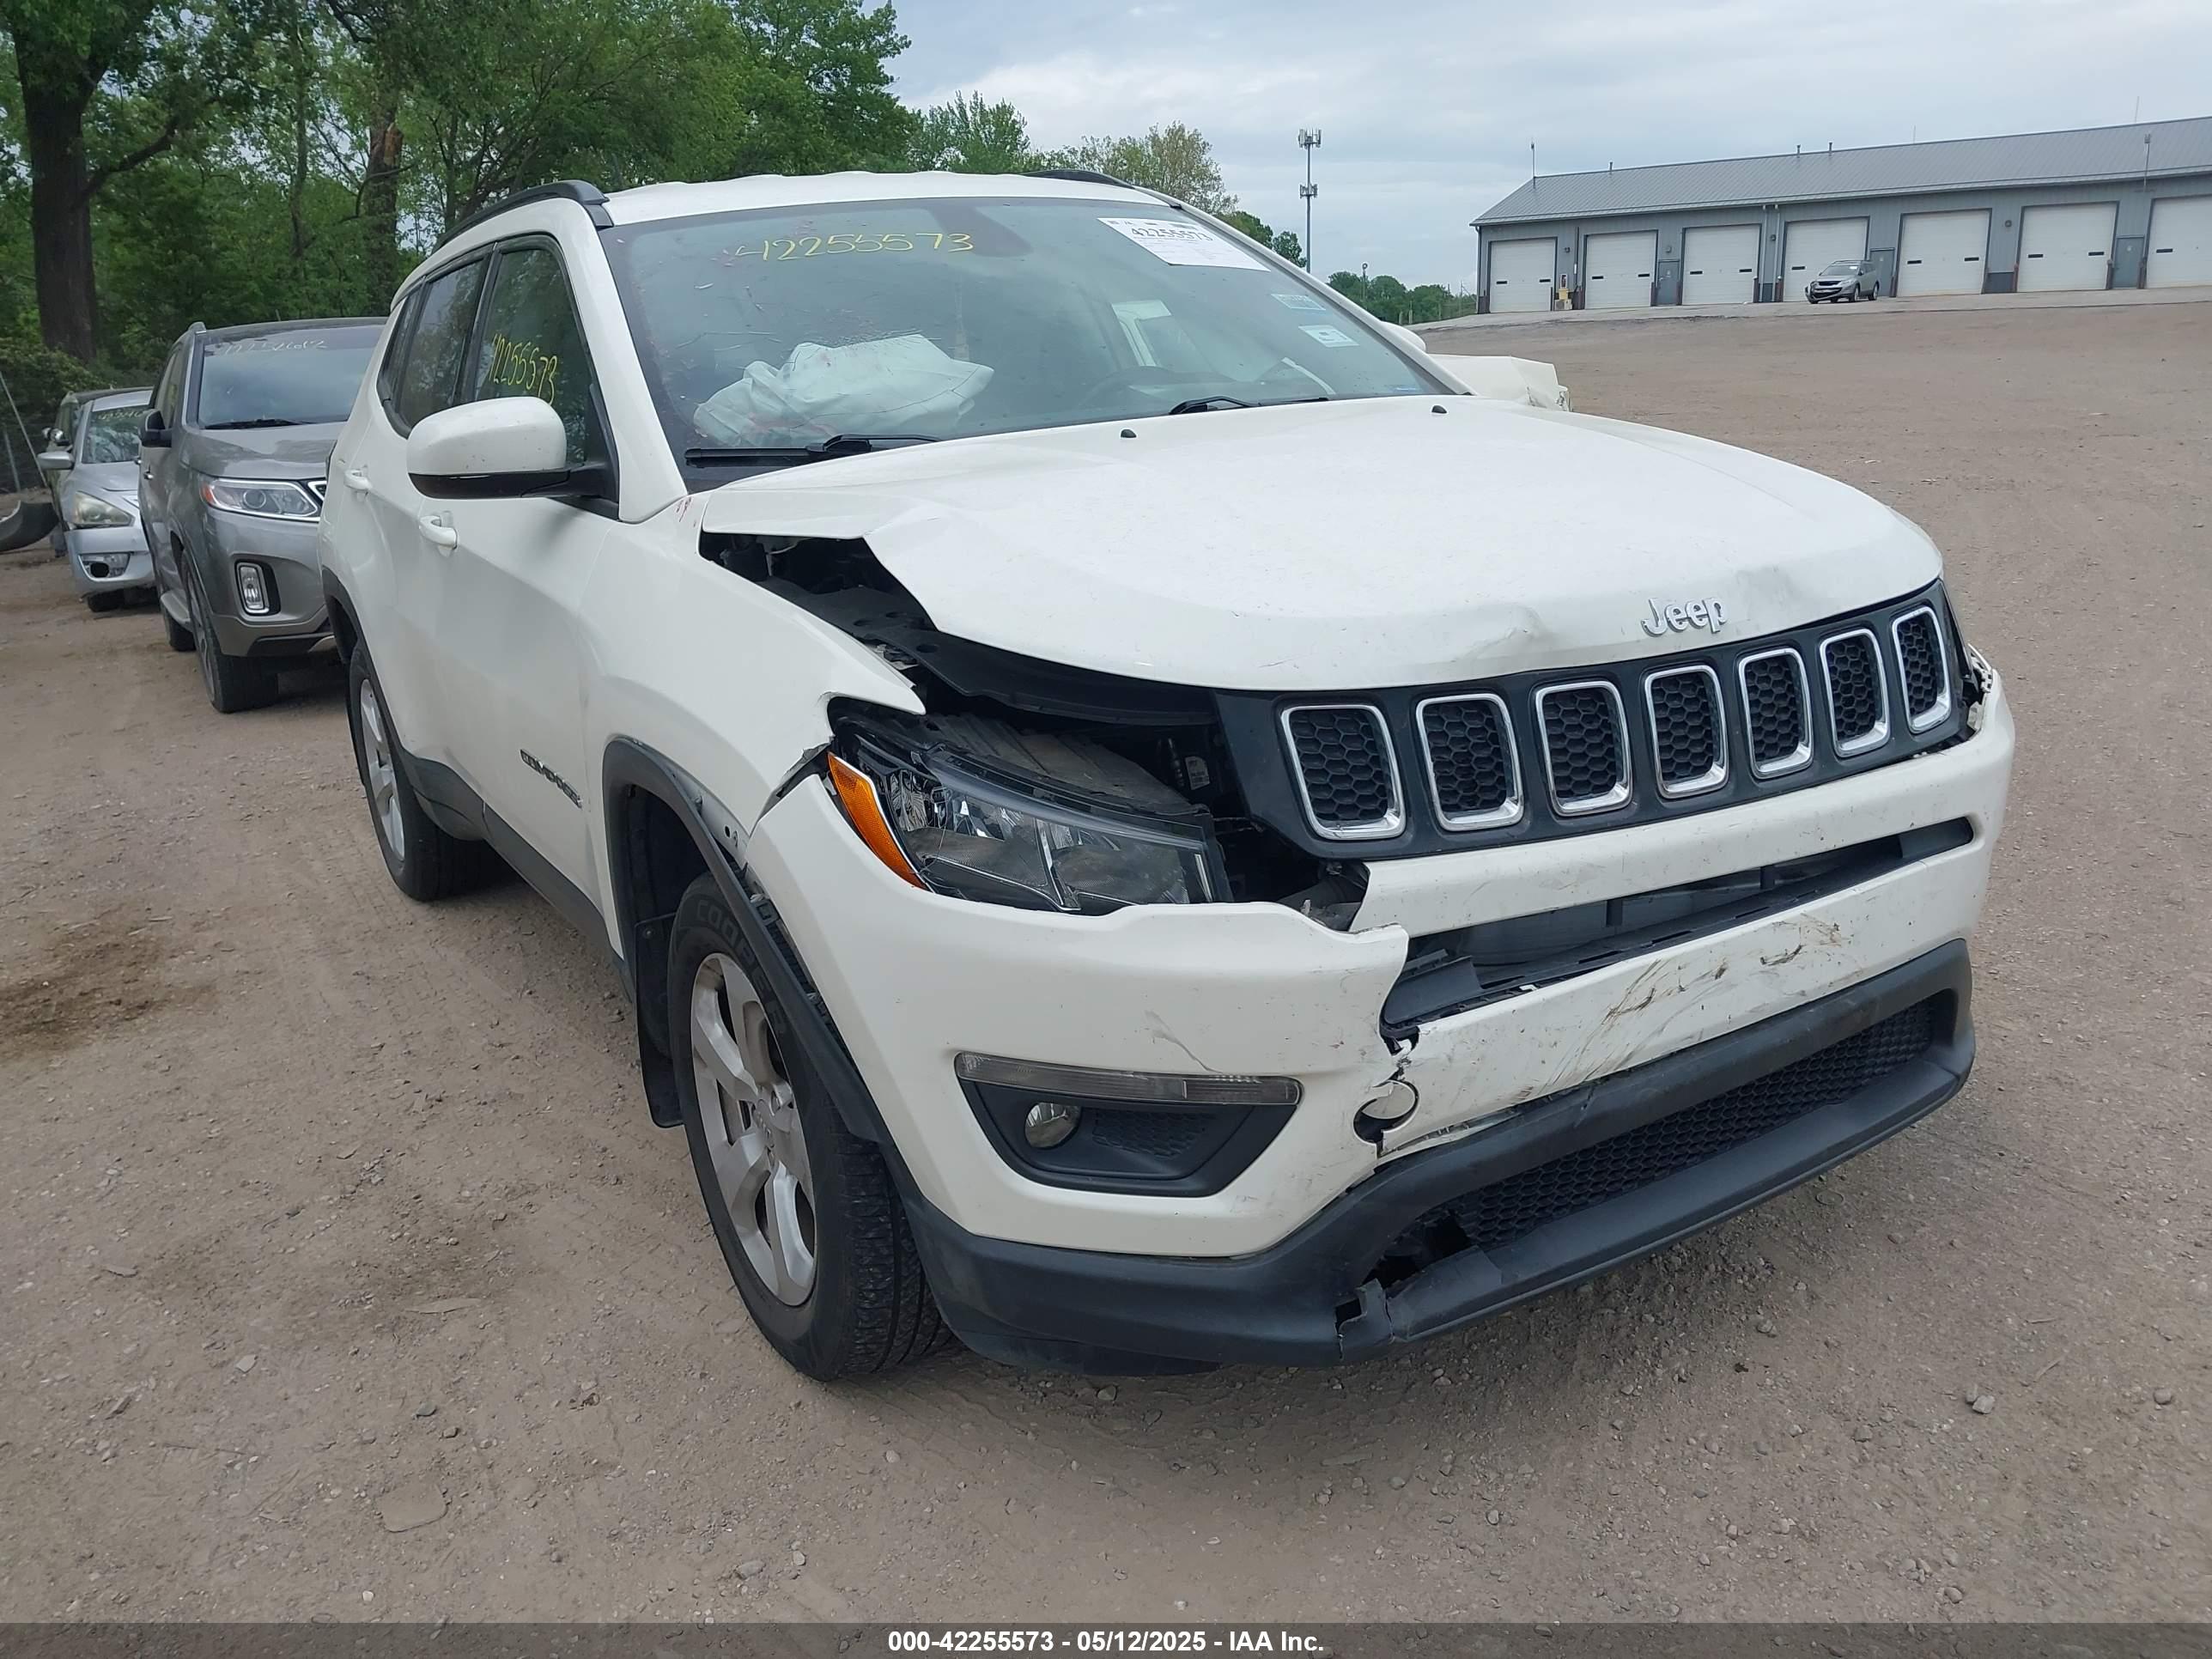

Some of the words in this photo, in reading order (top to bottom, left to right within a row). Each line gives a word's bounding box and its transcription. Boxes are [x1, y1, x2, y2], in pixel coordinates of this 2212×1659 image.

[734, 233, 975, 261] 42255573
[1131, 227, 1214, 241] 42255573
[489, 333, 557, 405] 42255573
[1641, 597, 1729, 637] Jeep
